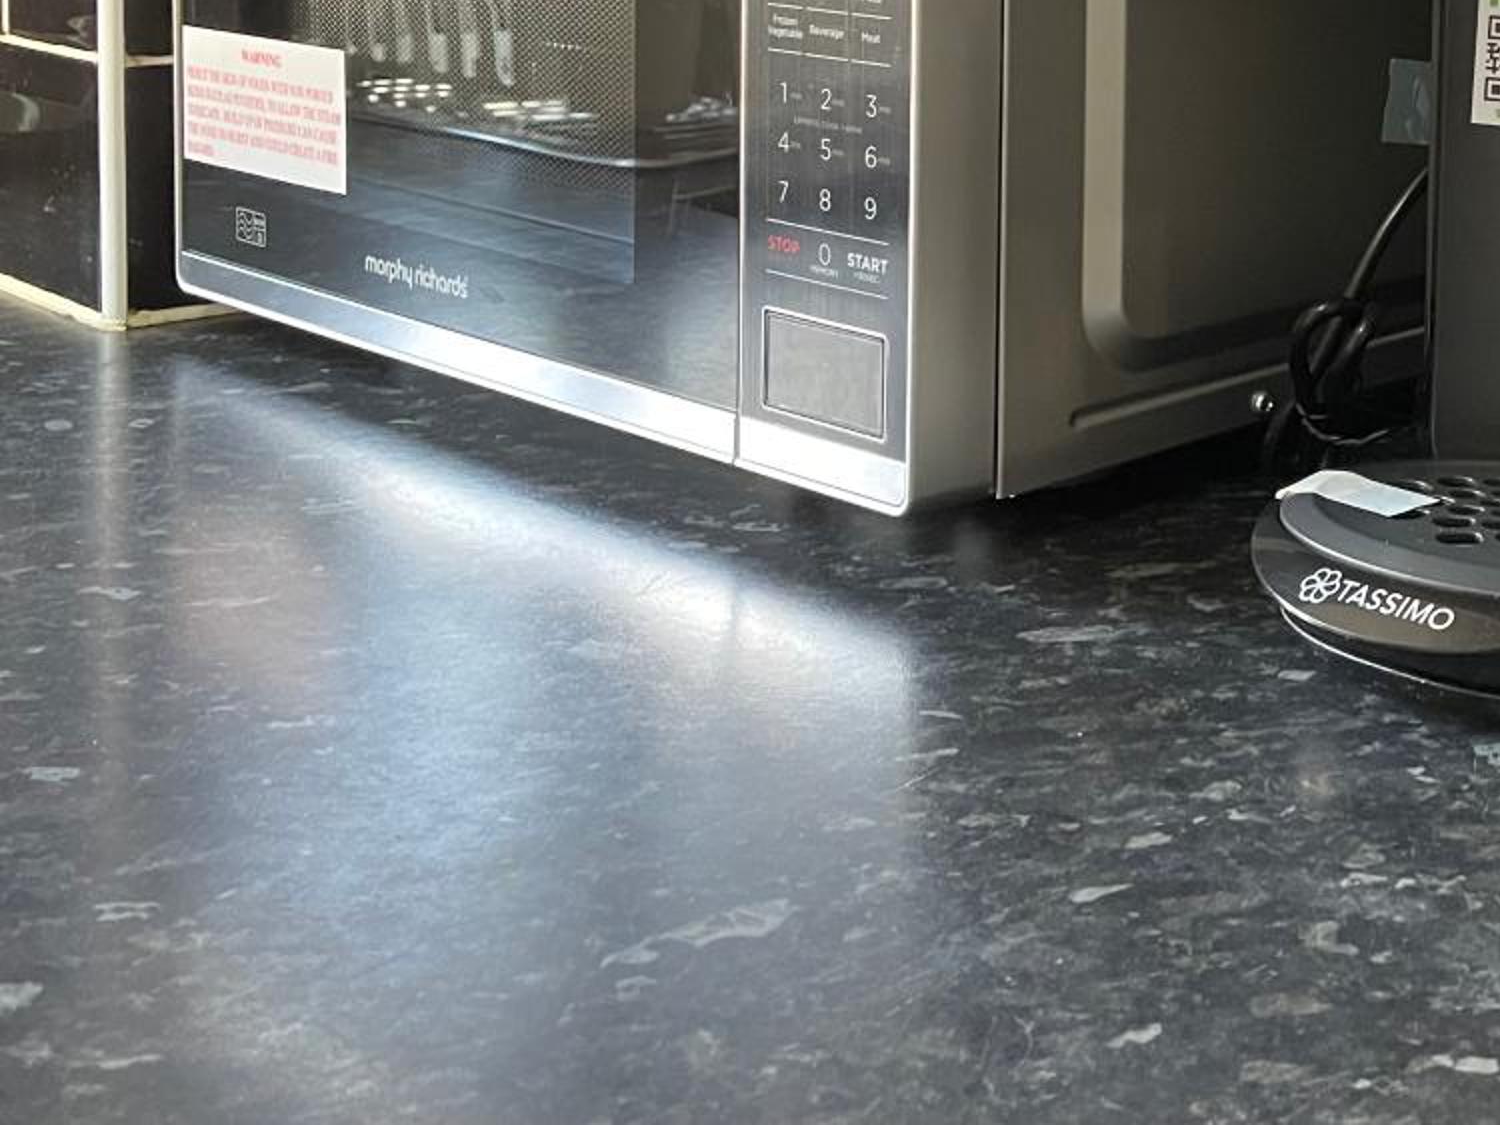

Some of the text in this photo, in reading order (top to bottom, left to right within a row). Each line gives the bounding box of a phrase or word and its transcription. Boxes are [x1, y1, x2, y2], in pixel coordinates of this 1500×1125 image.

[780, 81, 788, 104] 1
[820, 87, 833, 111] 2
[865, 93, 878, 118] 3
[777, 131, 790, 154] 4
[820, 137, 832, 161] 5
[864, 145, 878, 169] 6
[778, 180, 790, 204] 7
[819, 188, 832, 212] 8
[864, 196, 877, 221] 9
[767, 235, 801, 253] STOP
[818, 242, 832, 266] 0
[847, 252, 889, 275] START
[364, 254, 470, 300] morphy richards
[1337, 579, 1456, 631] TASSIMO
